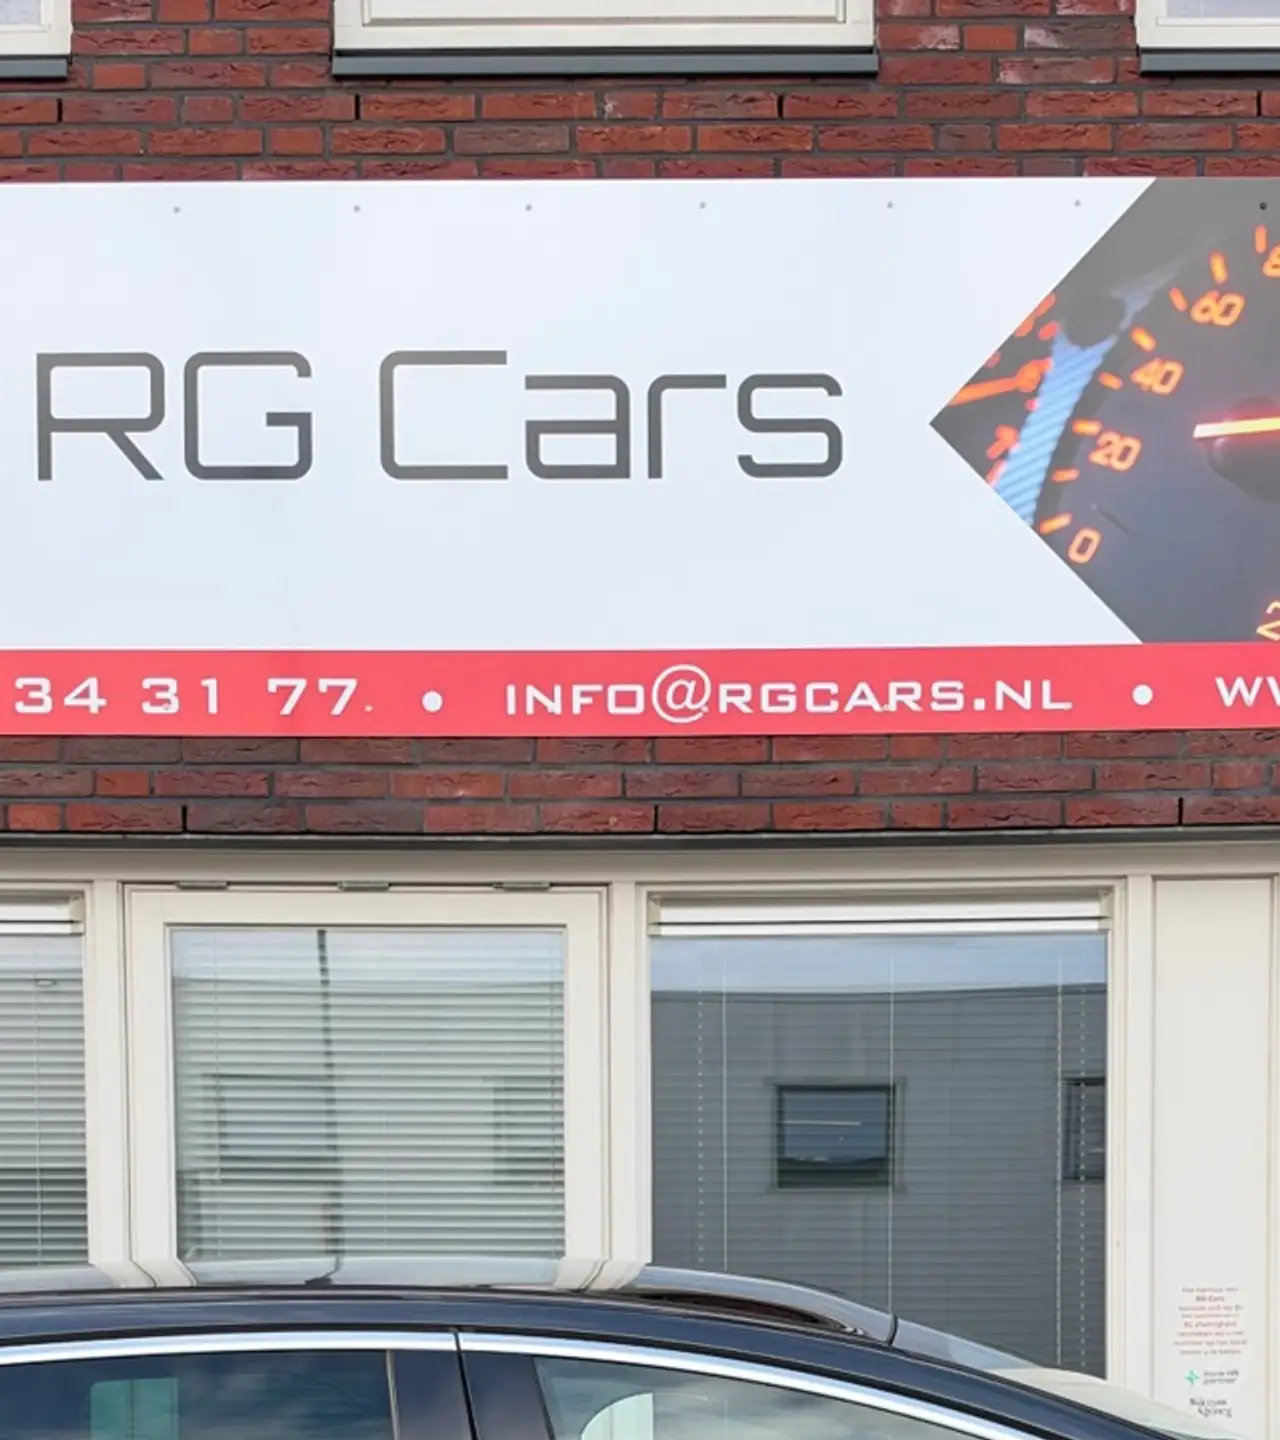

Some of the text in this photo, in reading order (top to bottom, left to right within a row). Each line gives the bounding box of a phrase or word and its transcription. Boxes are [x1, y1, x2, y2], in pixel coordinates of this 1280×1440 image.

[1188, 291, 1246, 327] 60
[1130, 358, 1184, 396] 40
[36, 350, 843, 481] RG Cars
[1087, 428, 1141, 473] 20
[1067, 527, 1101, 565] 0
[15, 677, 107, 714] 34
[142, 677, 218, 714] 31
[266, 677, 358, 716] 77
[506, 664, 1073, 724] INFO@RGCARS.NL
